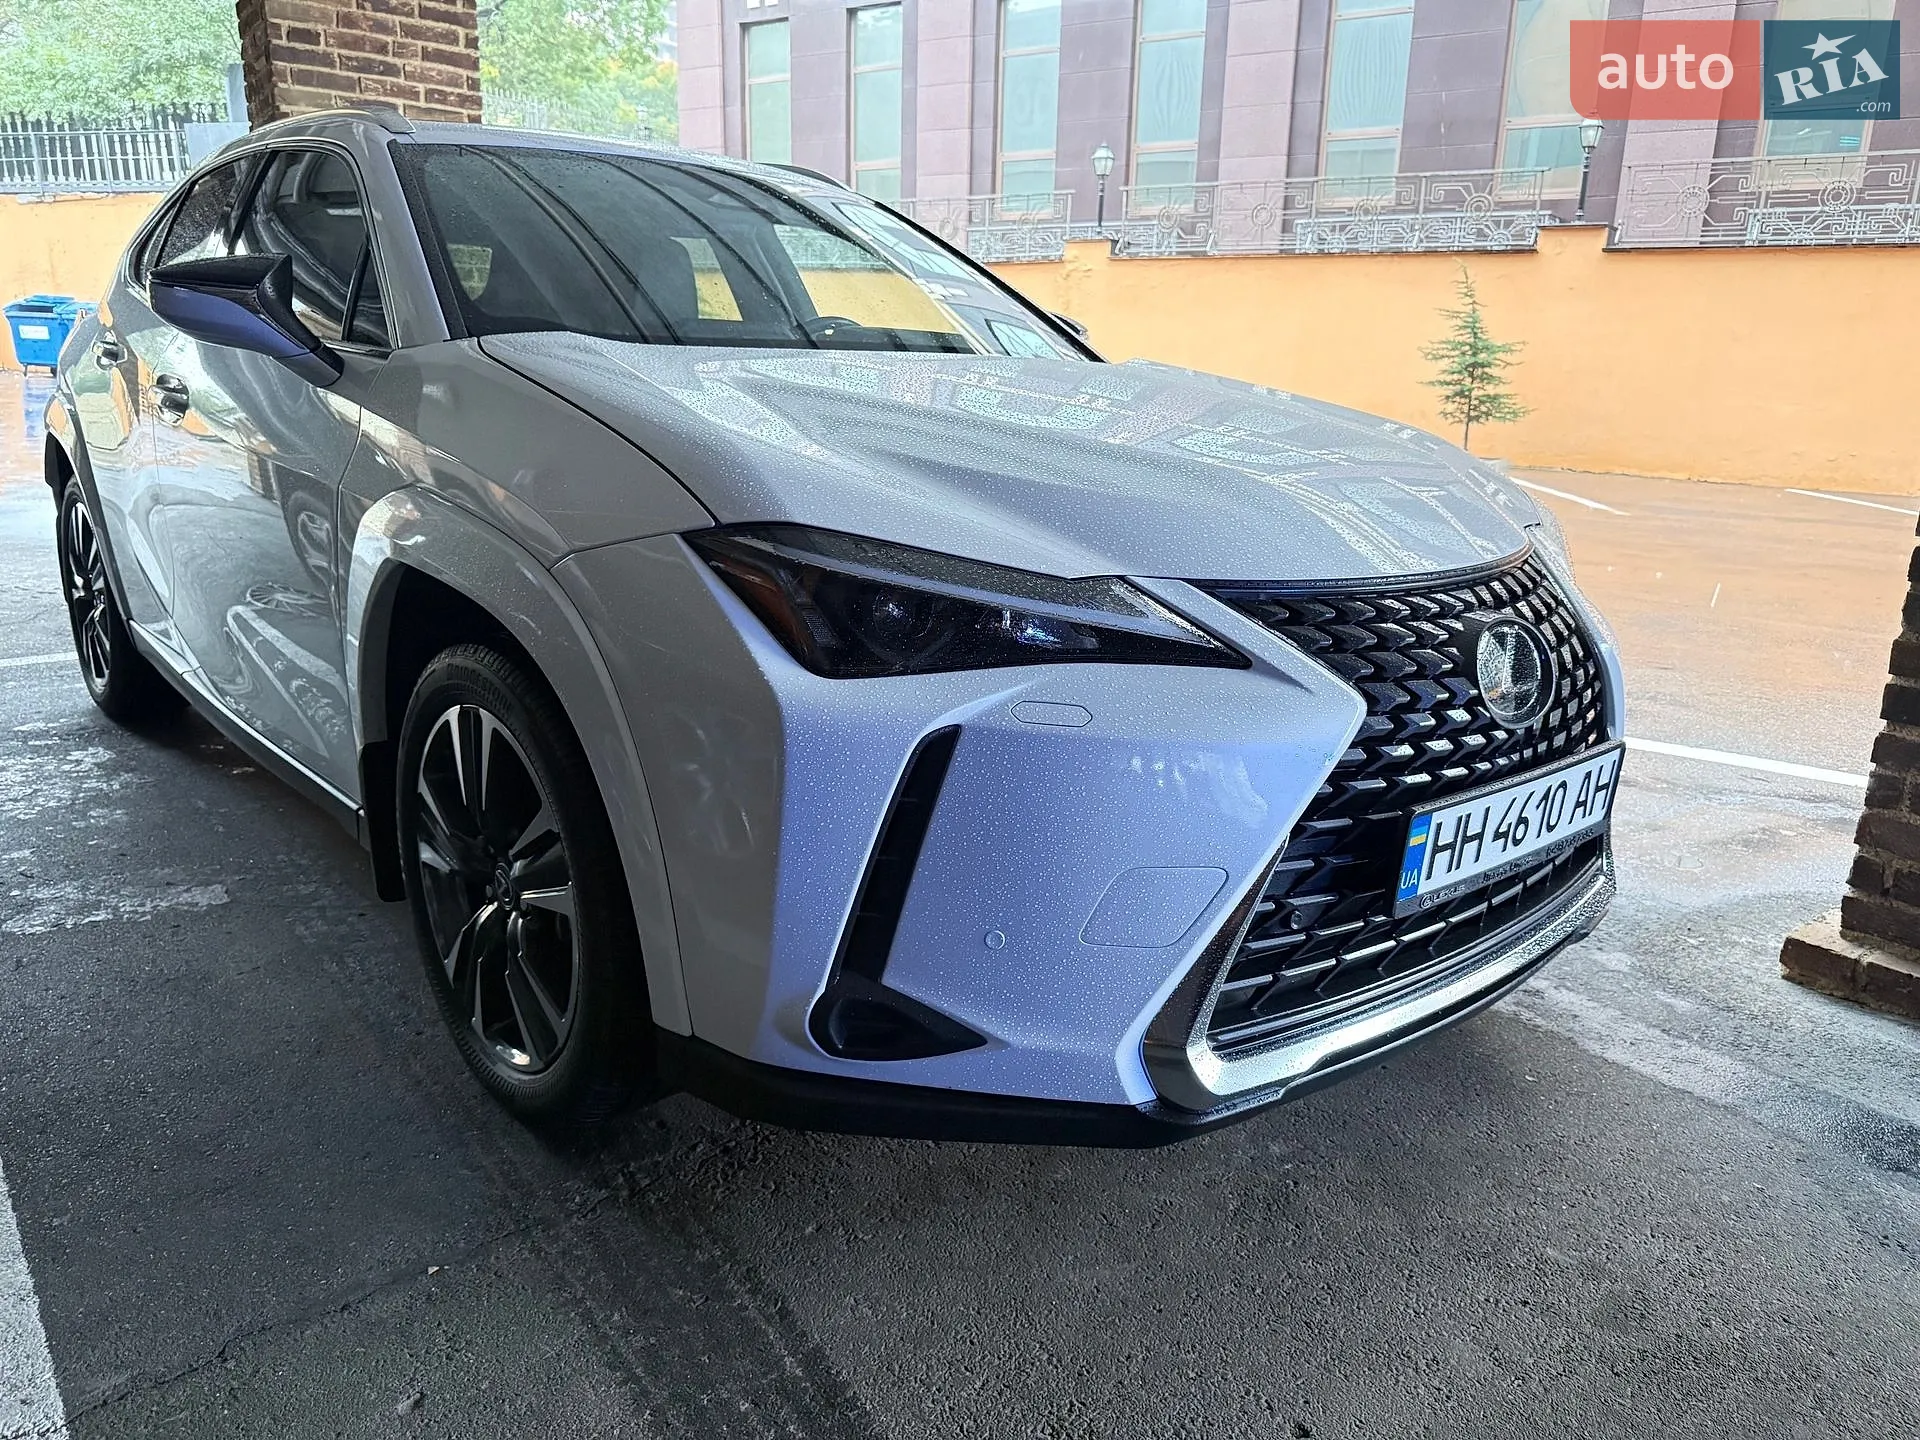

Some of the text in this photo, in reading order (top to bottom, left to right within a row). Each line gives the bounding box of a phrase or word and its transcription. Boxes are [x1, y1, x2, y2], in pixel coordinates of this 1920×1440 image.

[1425, 759, 1617, 881] HH 4610 AH
[1400, 867, 1419, 890] UA
